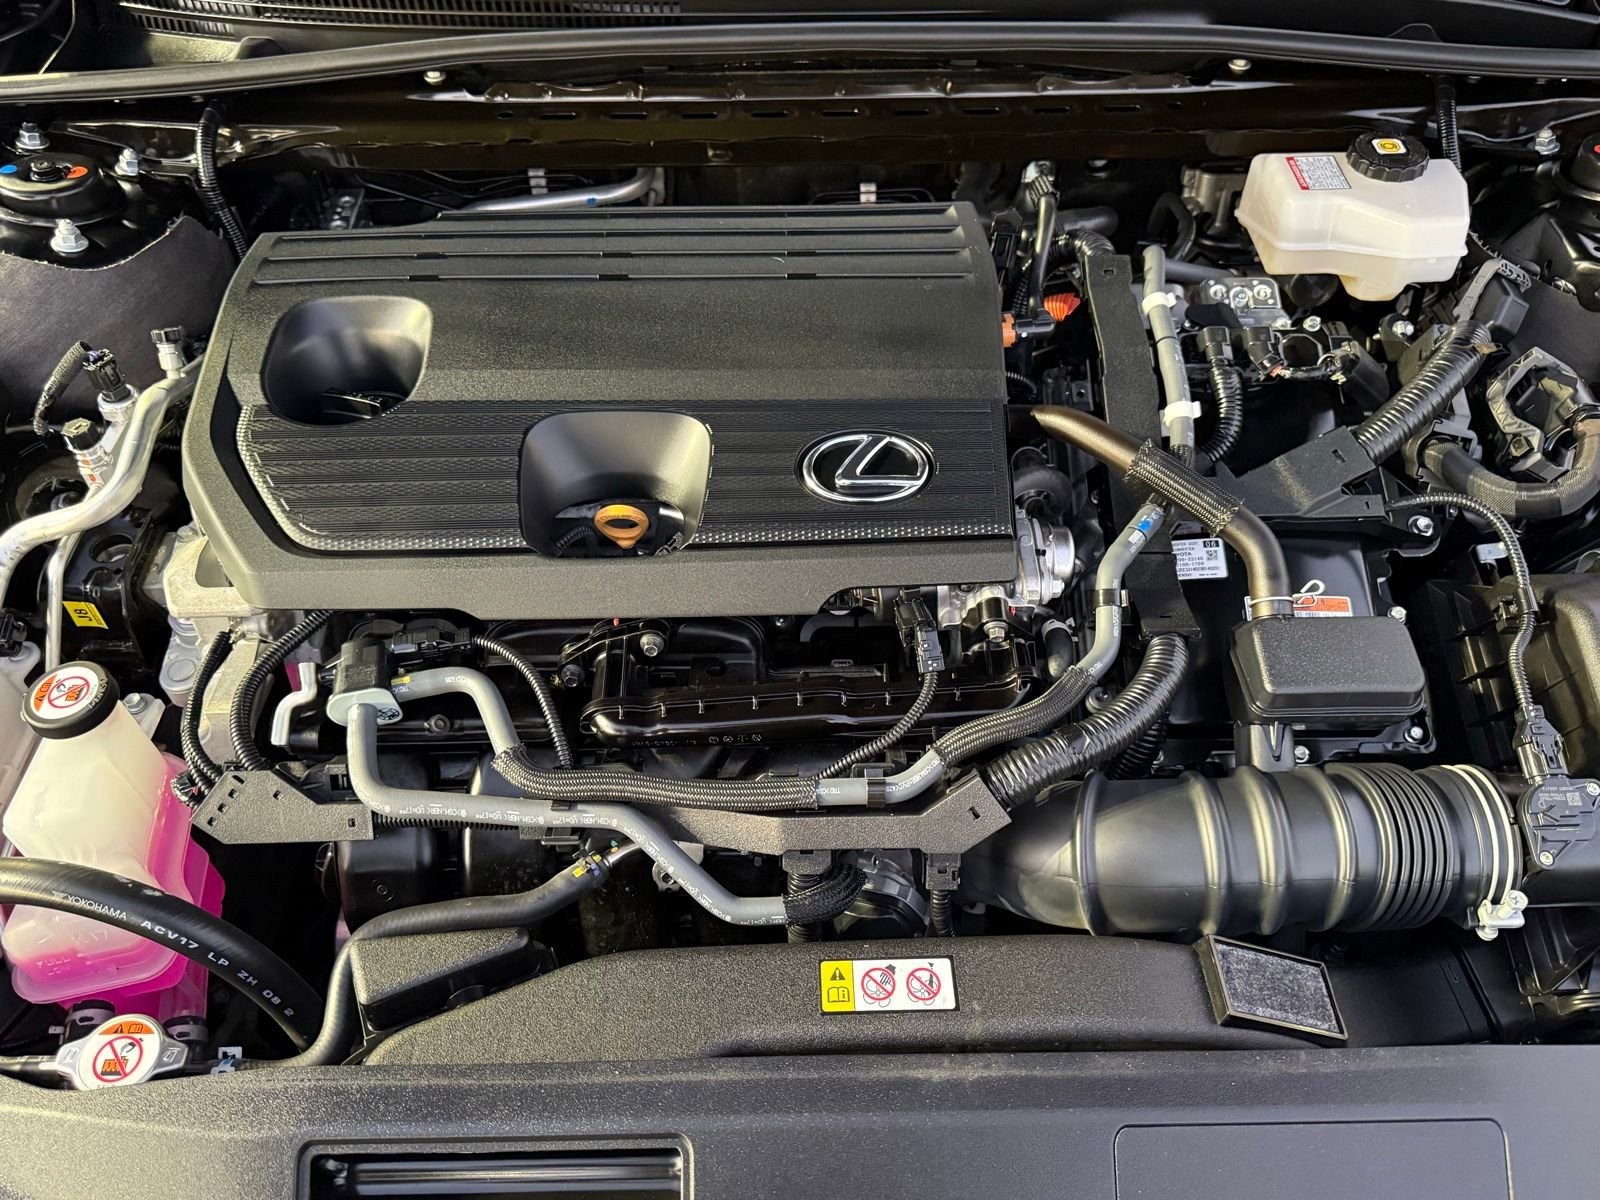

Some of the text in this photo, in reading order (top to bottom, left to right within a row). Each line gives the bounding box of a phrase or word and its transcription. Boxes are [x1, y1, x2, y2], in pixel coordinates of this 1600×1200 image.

[74, 608, 93, 622] J8
[67, 894, 127, 920] YOKOHAMA
[141, 920, 200, 949] ACV17
[207, 951, 230, 967] LP
[237, 969, 258, 986] ZH
[283, 1007, 295, 1017] 2
